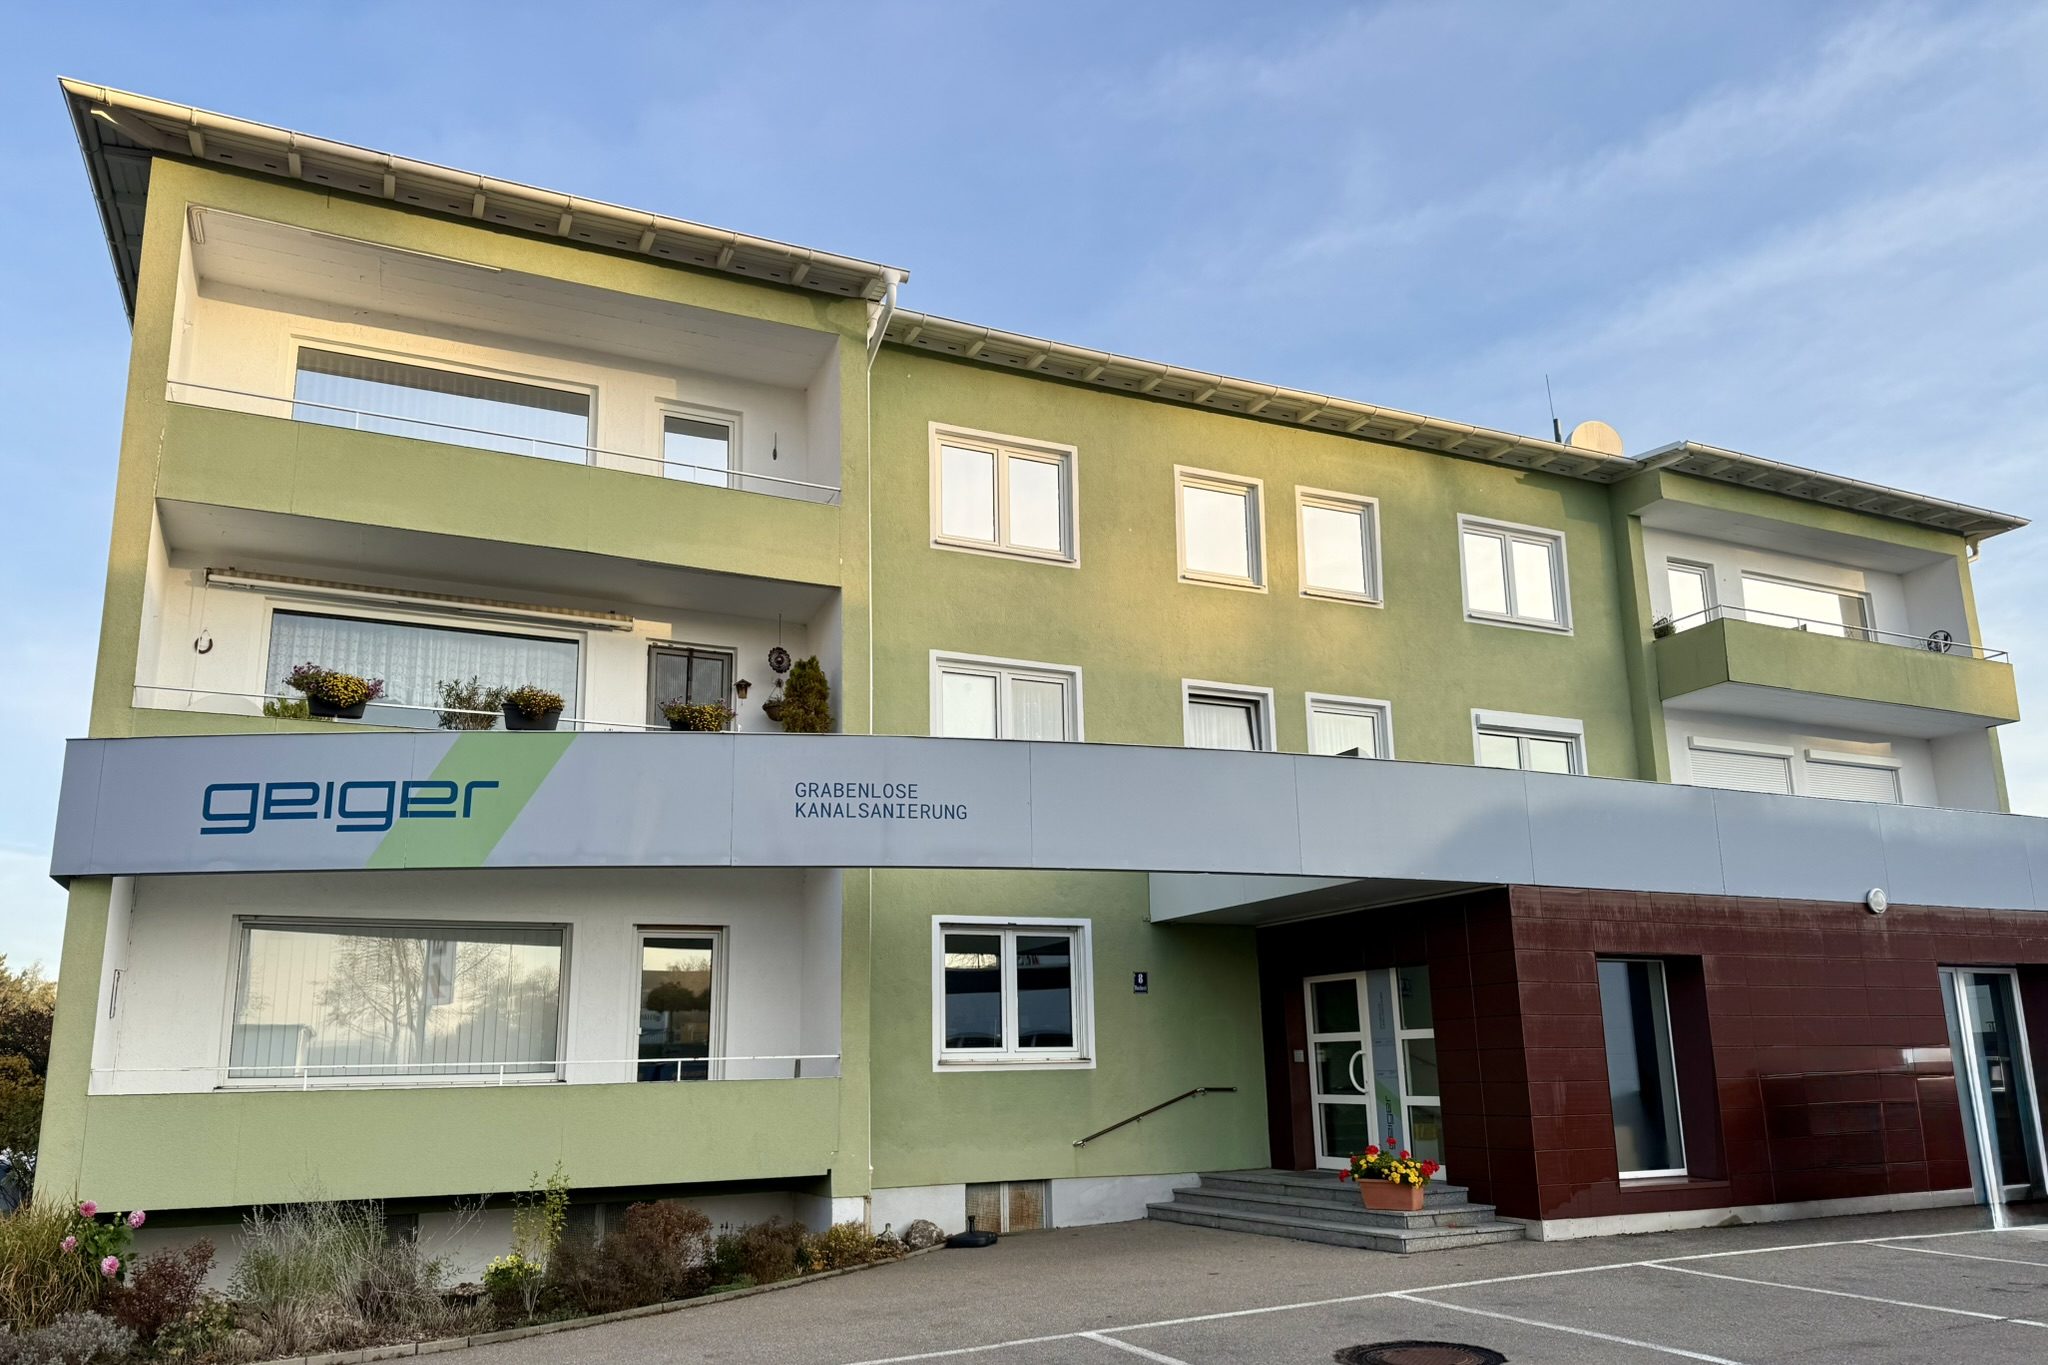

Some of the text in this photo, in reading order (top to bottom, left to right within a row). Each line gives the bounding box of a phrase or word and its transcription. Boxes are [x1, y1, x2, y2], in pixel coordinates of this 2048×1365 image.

[795, 782, 918, 799] GRABENLOSE
[200, 781, 499, 835] geiger
[795, 802, 968, 820] KANALSANIERUNG
[1138, 973, 1144, 984] 8
